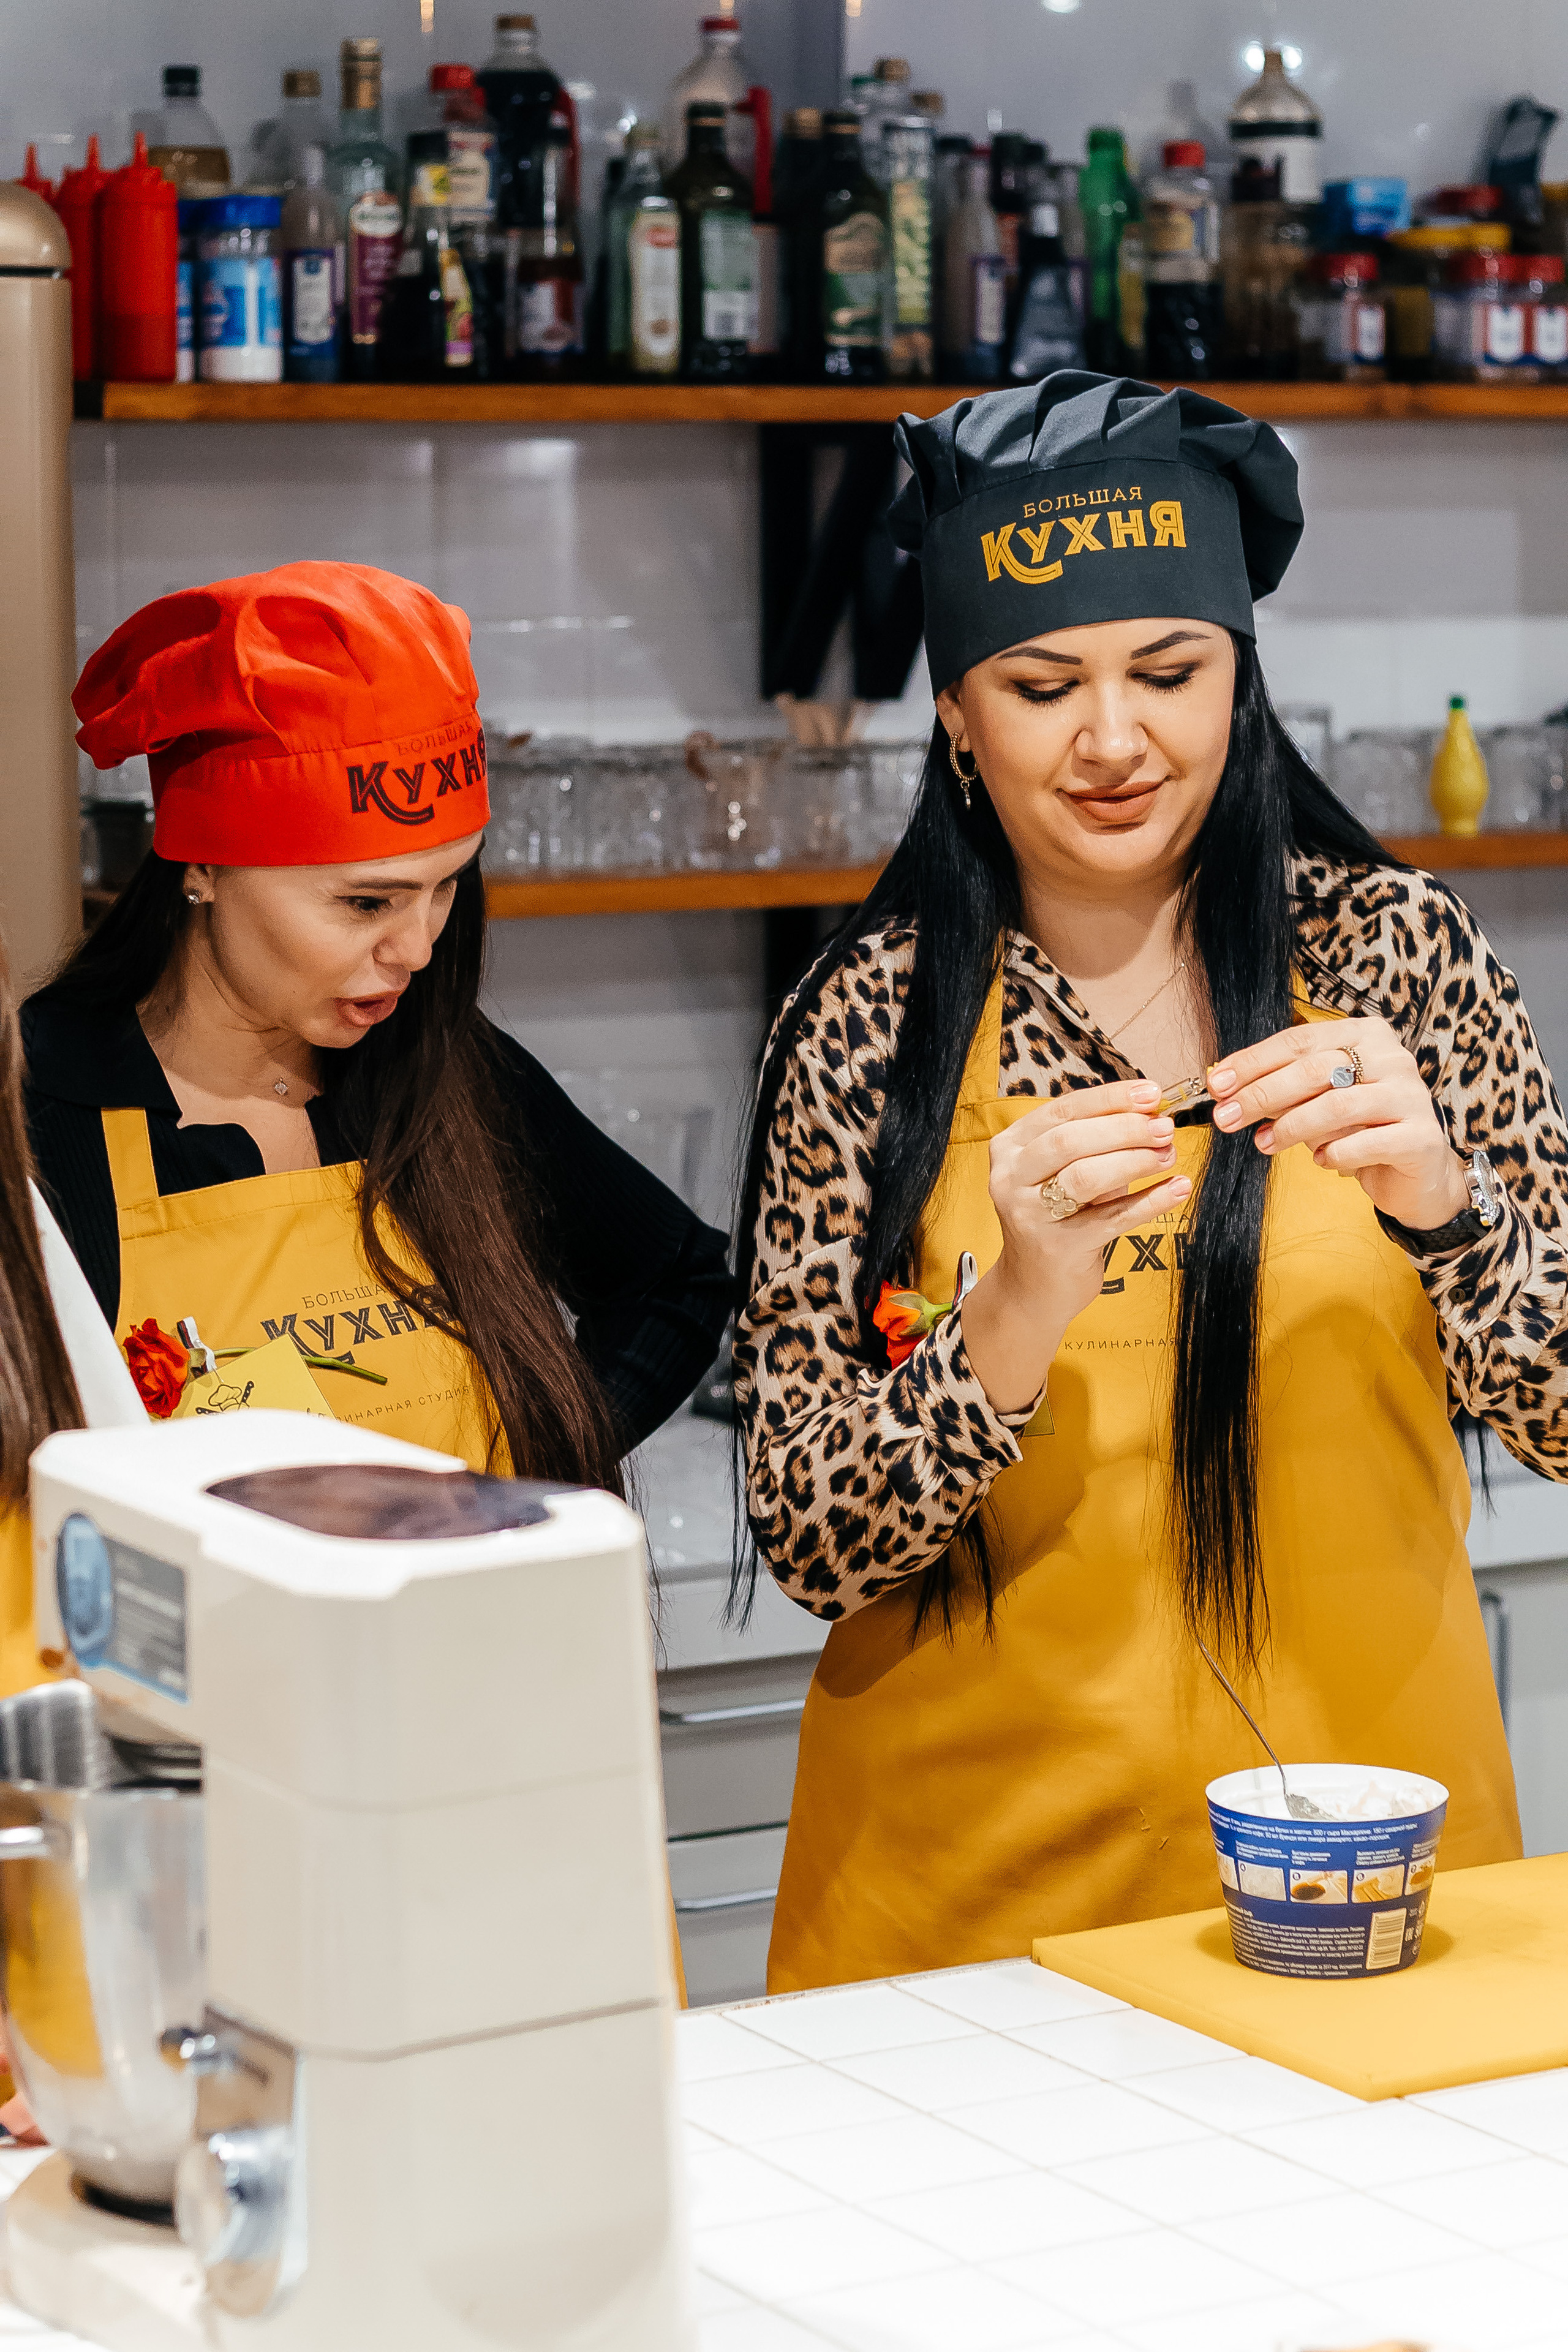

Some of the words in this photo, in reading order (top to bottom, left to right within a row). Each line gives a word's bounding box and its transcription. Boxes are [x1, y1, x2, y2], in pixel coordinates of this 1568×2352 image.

[1023, 486, 1142, 518] БОЛЬШАЯ
[981, 500, 1186, 584] КУХНЯ
[301, 1285, 387, 1308] БОЛЬША
